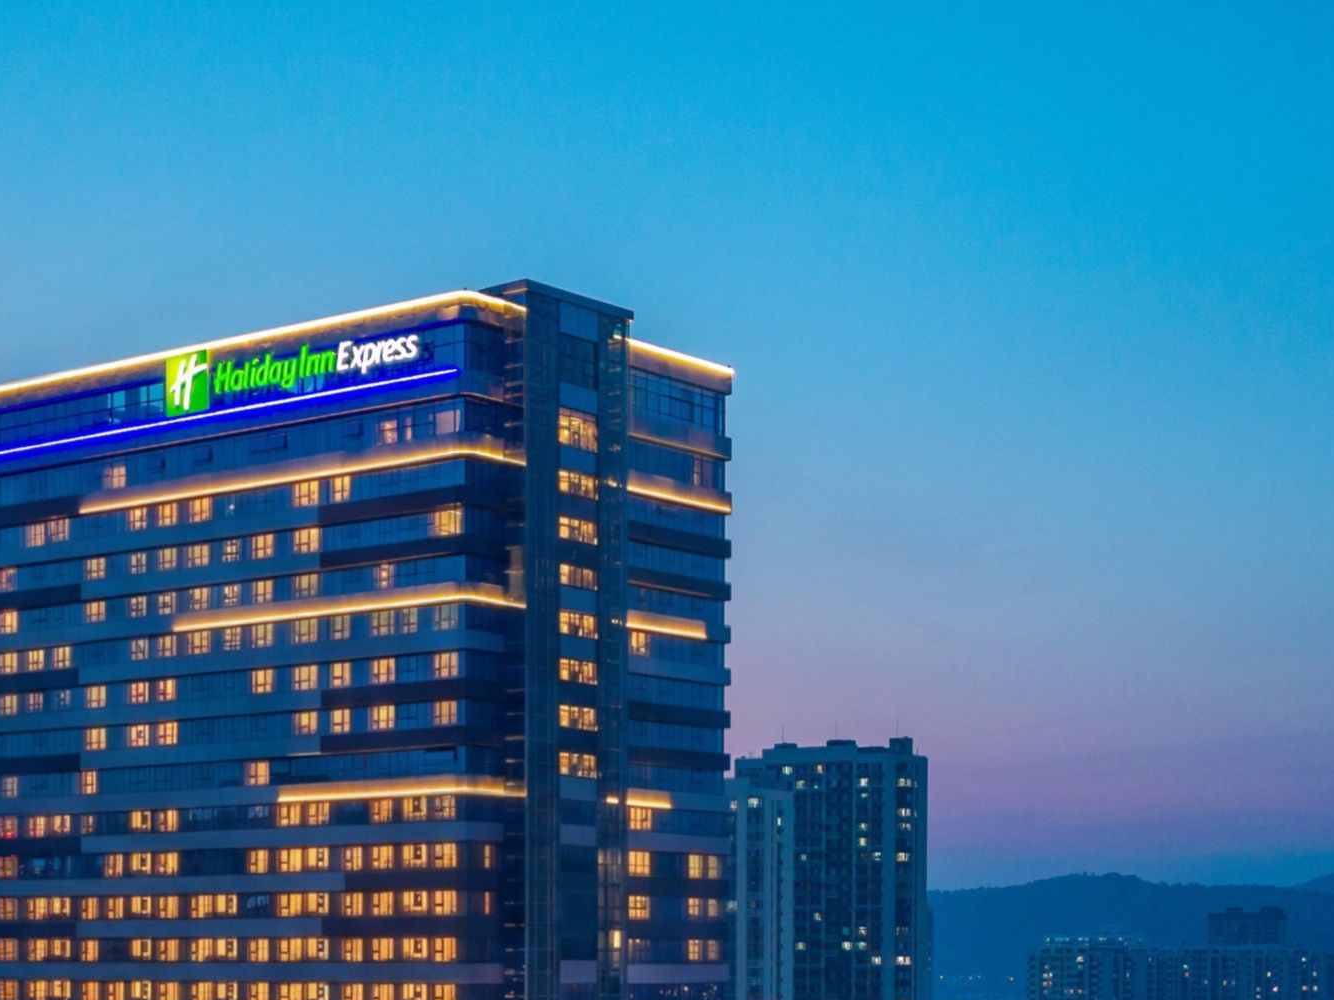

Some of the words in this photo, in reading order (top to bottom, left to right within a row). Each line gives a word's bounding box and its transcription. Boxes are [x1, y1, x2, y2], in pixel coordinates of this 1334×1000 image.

[213, 352, 298, 395] Holiday
[298, 343, 336, 378] Inn
[336, 334, 419, 375] Express
